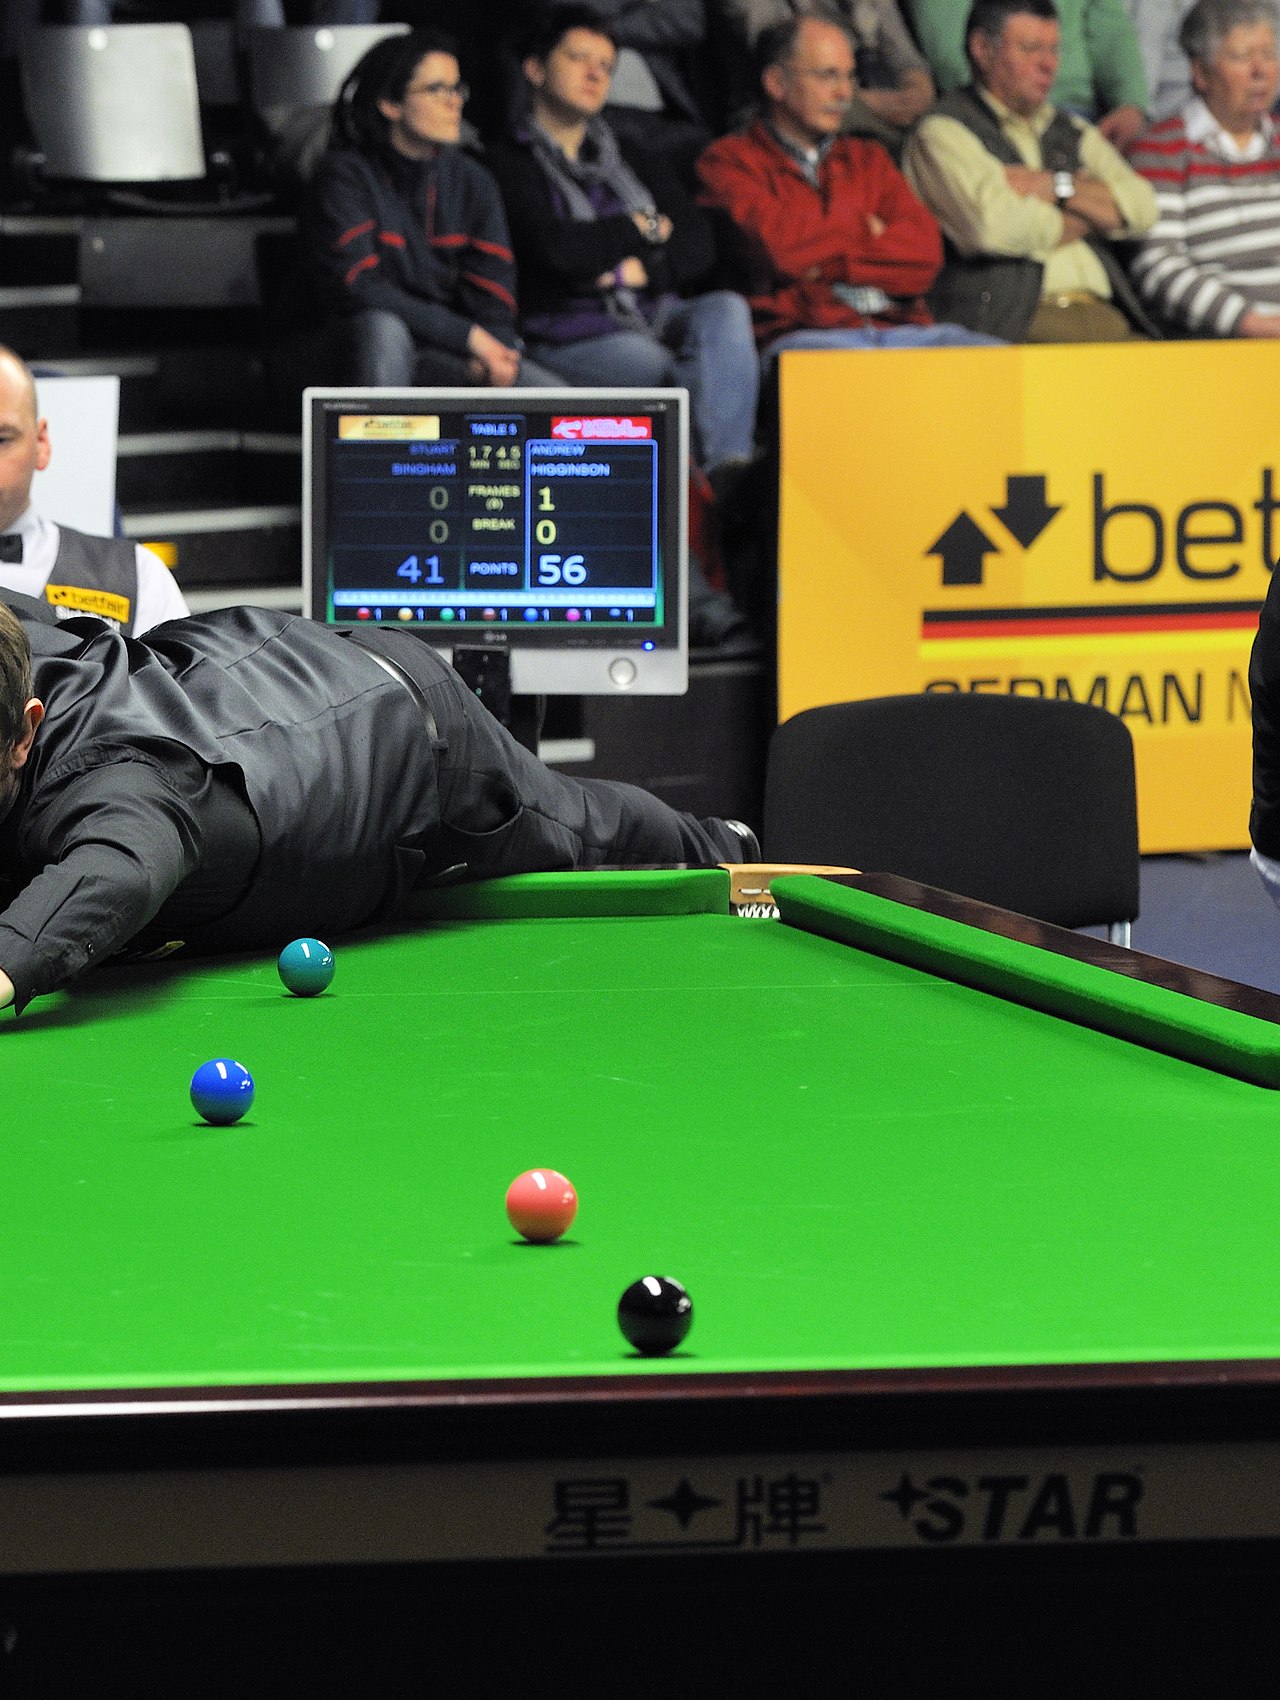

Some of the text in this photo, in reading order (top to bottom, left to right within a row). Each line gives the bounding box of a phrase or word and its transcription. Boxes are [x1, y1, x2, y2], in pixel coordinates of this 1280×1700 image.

[470, 423, 508, 436] TABLE
[408, 444, 458, 456] STUART
[531, 444, 586, 457] ANDREW
[391, 463, 457, 477] BINGHAM
[531, 463, 611, 477] HIGGINSON
[429, 486, 449, 512] 0
[468, 485, 521, 498] FRAMES
[537, 486, 556, 511] 1
[429, 519, 449, 545] 0
[472, 517, 516, 531] BREAK
[536, 519, 557, 545] 0
[396, 554, 445, 584] 41
[469, 560, 519, 576] POINTS
[538, 554, 587, 585] 56
[915, 1471, 1145, 1543] STAR
